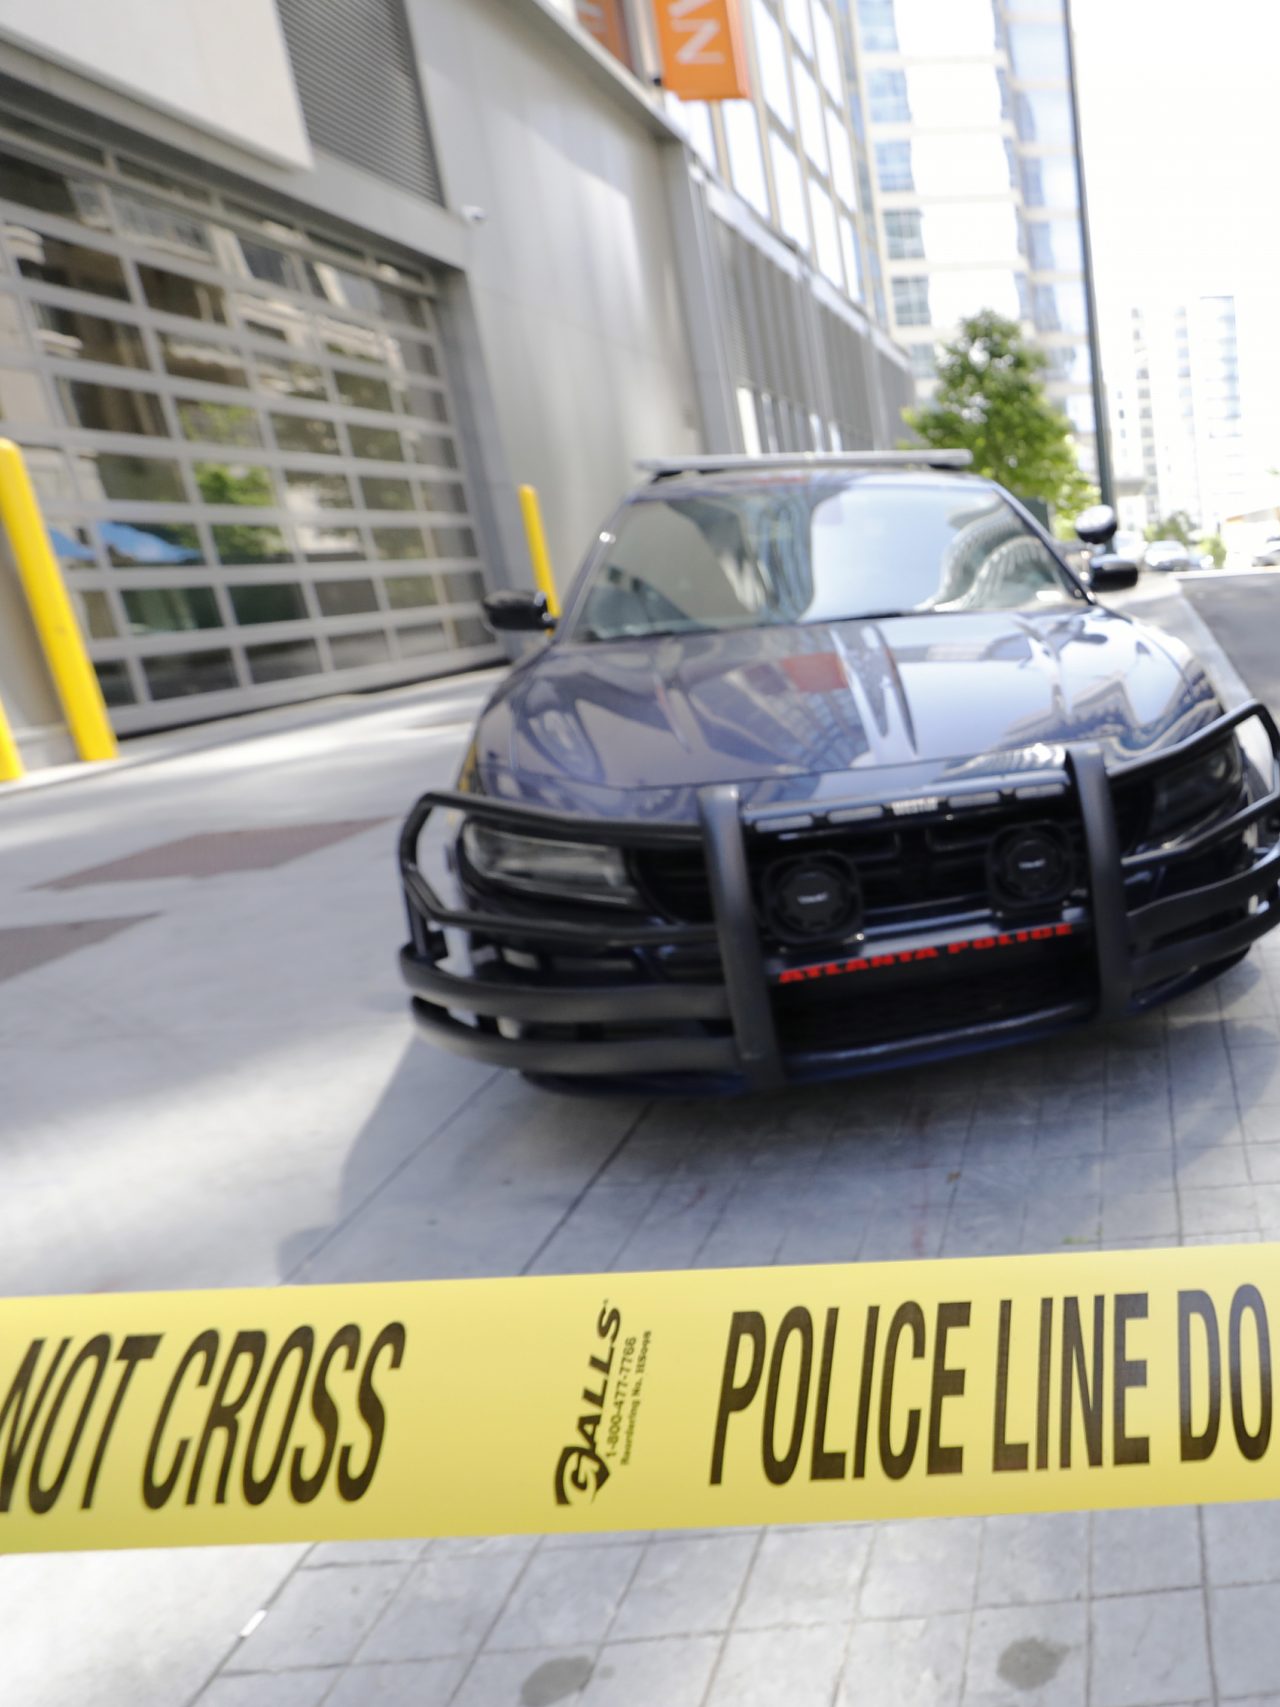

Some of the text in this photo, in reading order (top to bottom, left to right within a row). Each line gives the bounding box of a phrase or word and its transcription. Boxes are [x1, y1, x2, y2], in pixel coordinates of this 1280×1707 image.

[778, 923, 1072, 984] ATLANTA POLICE
[141, 1321, 406, 1510] CROSS
[606, 1336, 637, 1458] 1-800-477-7766
[709, 1300, 972, 1486] POLICE
[992, 1292, 1150, 1473] LINE
[1177, 1284, 1273, 1463] DO
